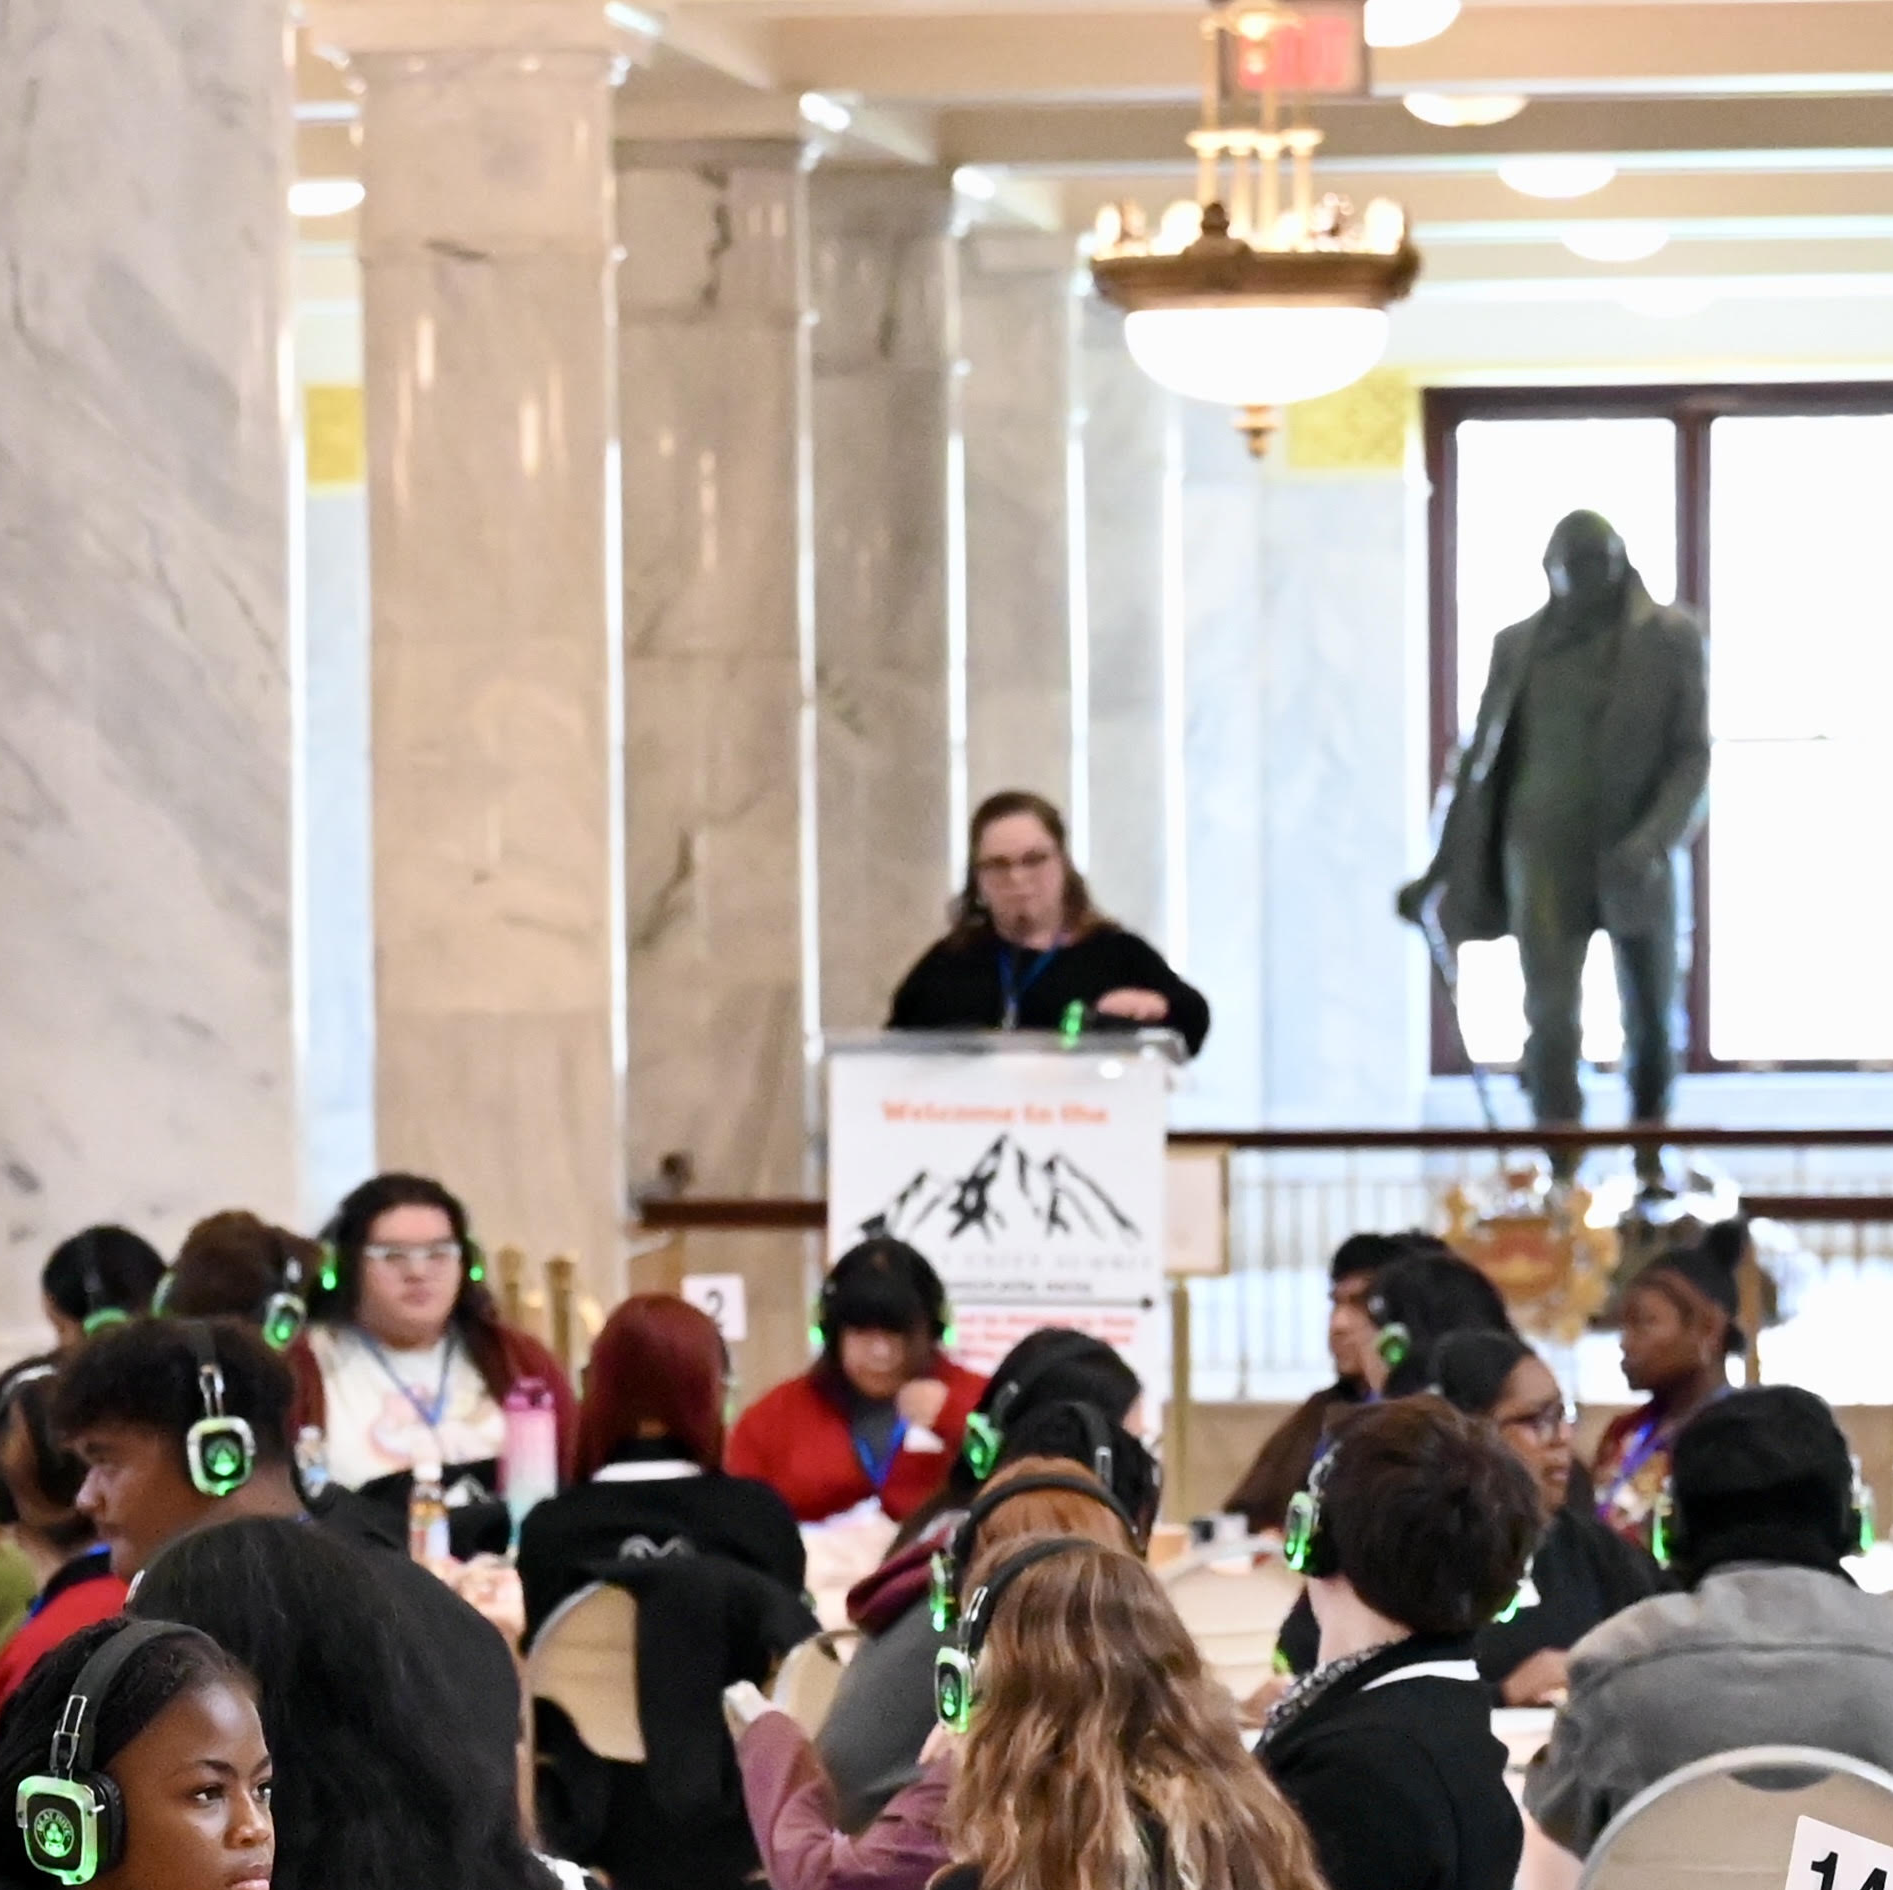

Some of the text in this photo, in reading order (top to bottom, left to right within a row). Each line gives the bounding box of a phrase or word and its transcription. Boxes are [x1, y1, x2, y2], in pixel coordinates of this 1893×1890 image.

[884, 1103, 1108, 1124] Welcome to the
